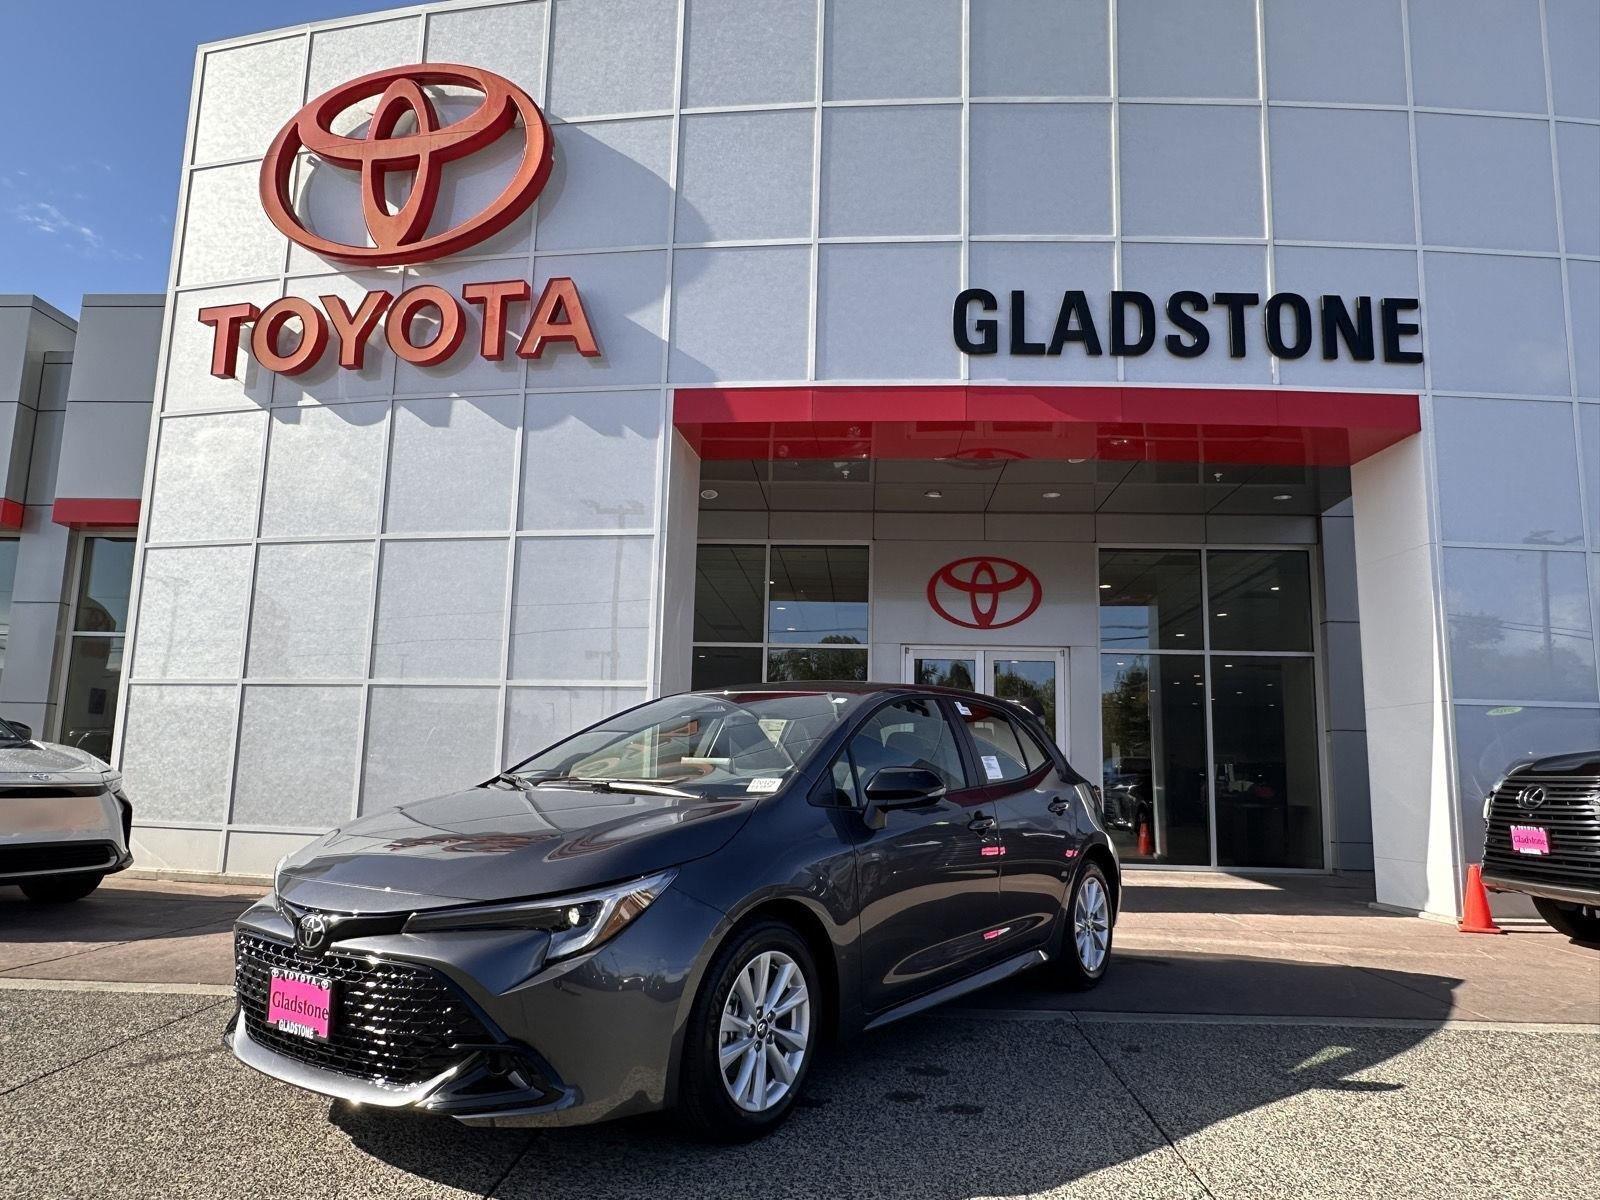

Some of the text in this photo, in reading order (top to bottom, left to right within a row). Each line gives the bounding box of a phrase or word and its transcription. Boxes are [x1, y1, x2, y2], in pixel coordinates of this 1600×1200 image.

[198, 277, 602, 379] TOYOTA
[953, 288, 1424, 364] GLADSTONE
[283, 969, 318, 987] TOYOTA
[272, 991, 330, 1020] Gladstone
[278, 1018, 314, 1039] GLADSTONE
